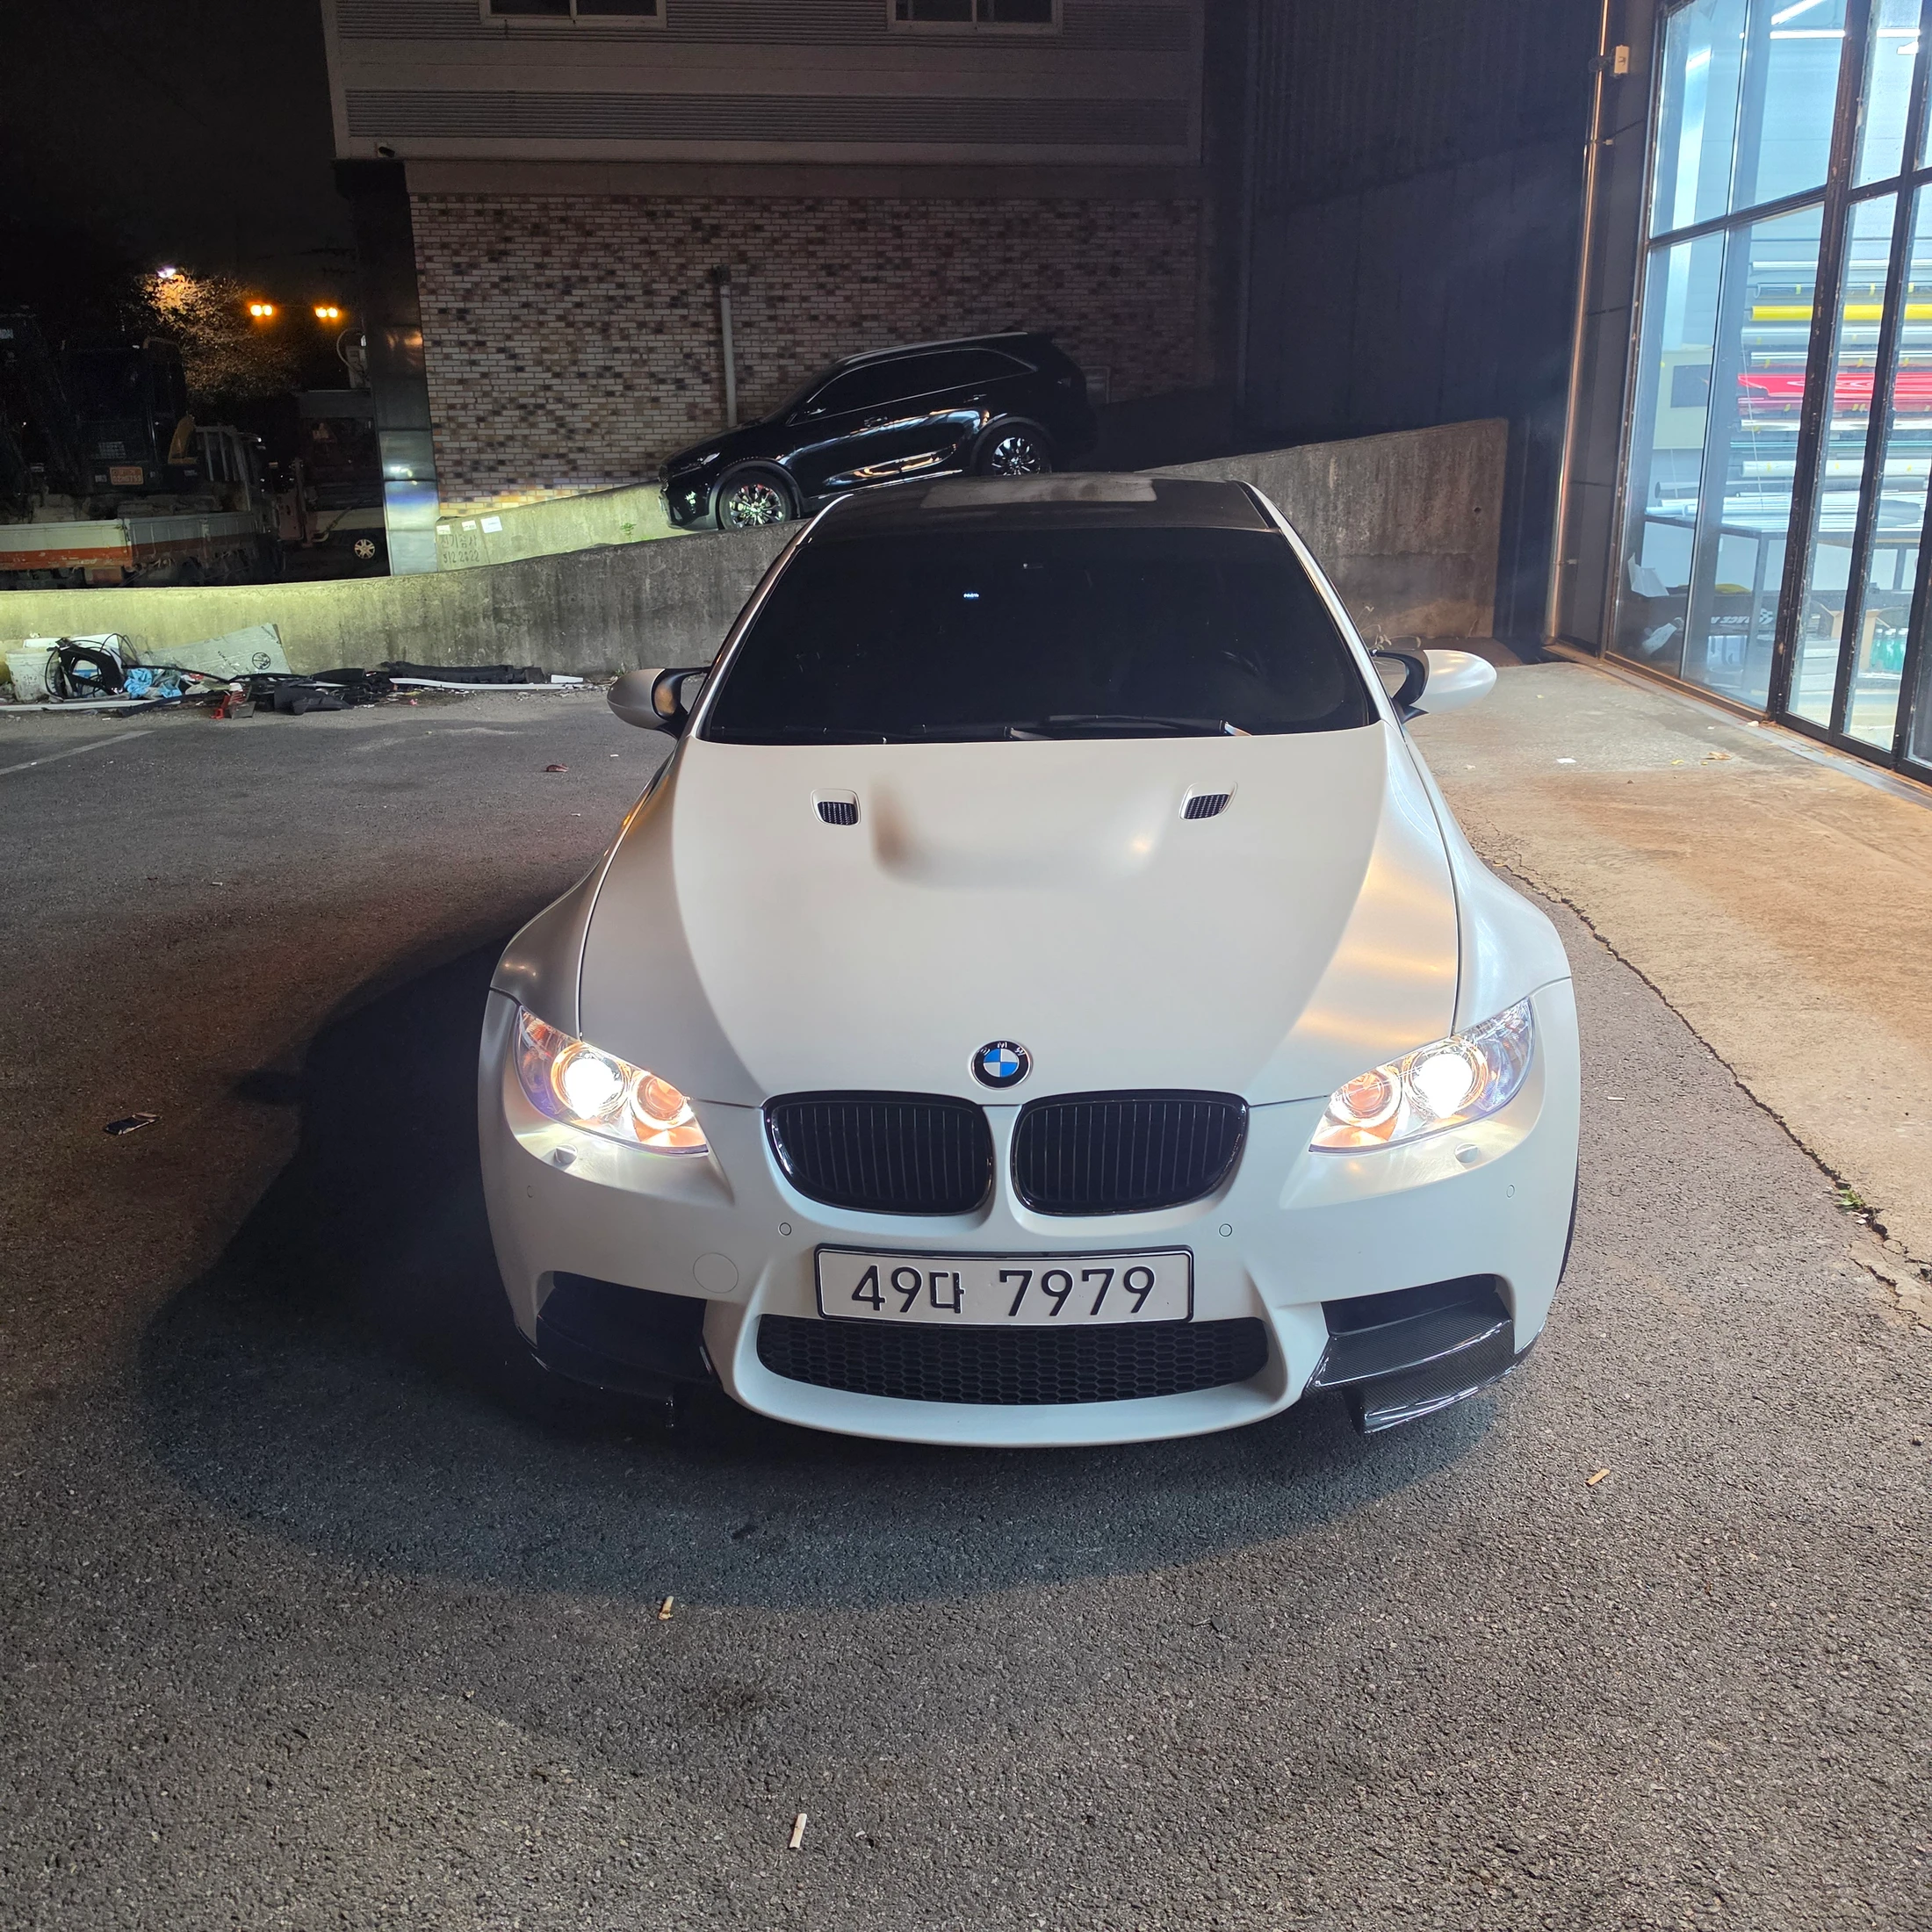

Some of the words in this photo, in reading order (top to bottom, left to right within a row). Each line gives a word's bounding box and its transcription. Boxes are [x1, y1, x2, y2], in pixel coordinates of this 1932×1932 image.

[980, 1042, 1026, 1056] BMW
[851, 1265, 965, 1314] 49다
[998, 1266, 1156, 1316] 7979
